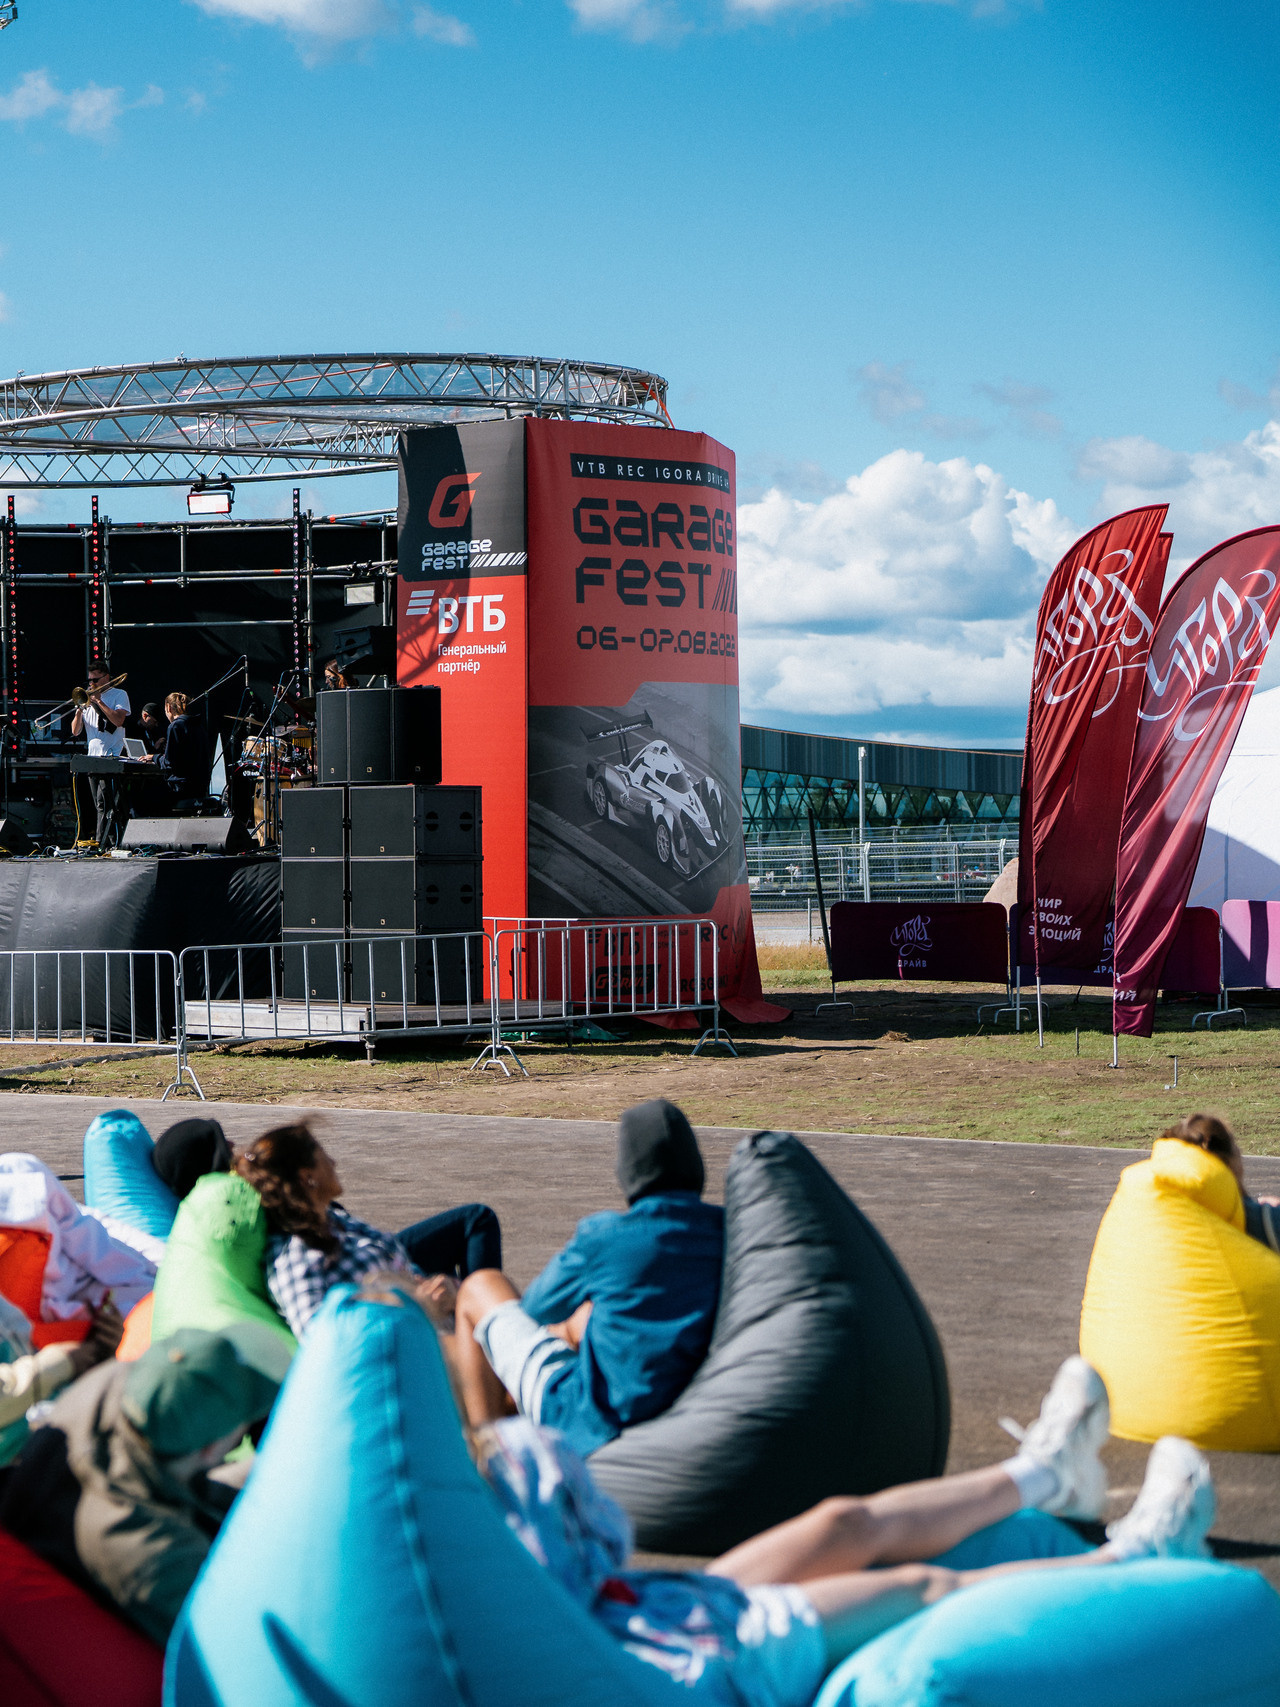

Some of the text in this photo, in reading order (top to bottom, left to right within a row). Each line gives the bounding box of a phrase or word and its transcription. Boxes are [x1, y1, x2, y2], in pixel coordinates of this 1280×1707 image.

[577, 461, 606, 475] VTB
[617, 464, 645, 477] REC
[655, 467, 702, 481] IGORA
[438, 594, 506, 634] ВТБ
[437, 641, 507, 659] Генеральный
[437, 659, 481, 675] партнёр
